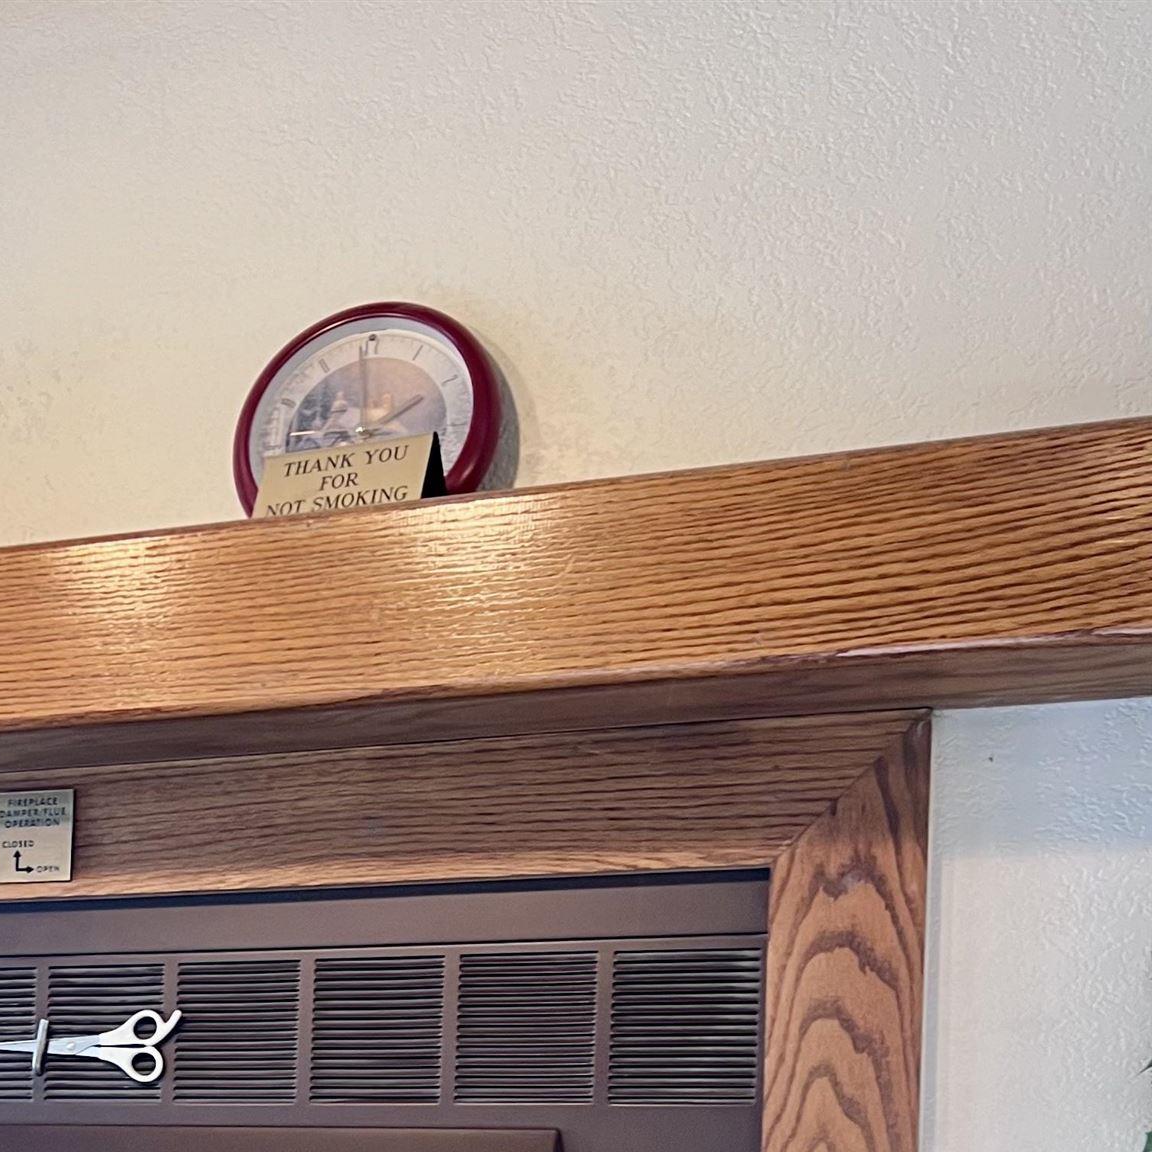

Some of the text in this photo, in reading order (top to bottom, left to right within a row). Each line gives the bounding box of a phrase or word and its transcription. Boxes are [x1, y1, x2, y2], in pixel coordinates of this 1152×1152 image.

[284, 445, 409, 477] THANK YOU
[319, 472, 358, 491] FOR
[266, 485, 408, 516] NOT SMOKING
[8, 797, 58, 807] FIREPLACE
[4, 818, 60, 828] OPERATION
[2, 840, 35, 848] CLOSED
[36, 865, 60, 873] OPEN
